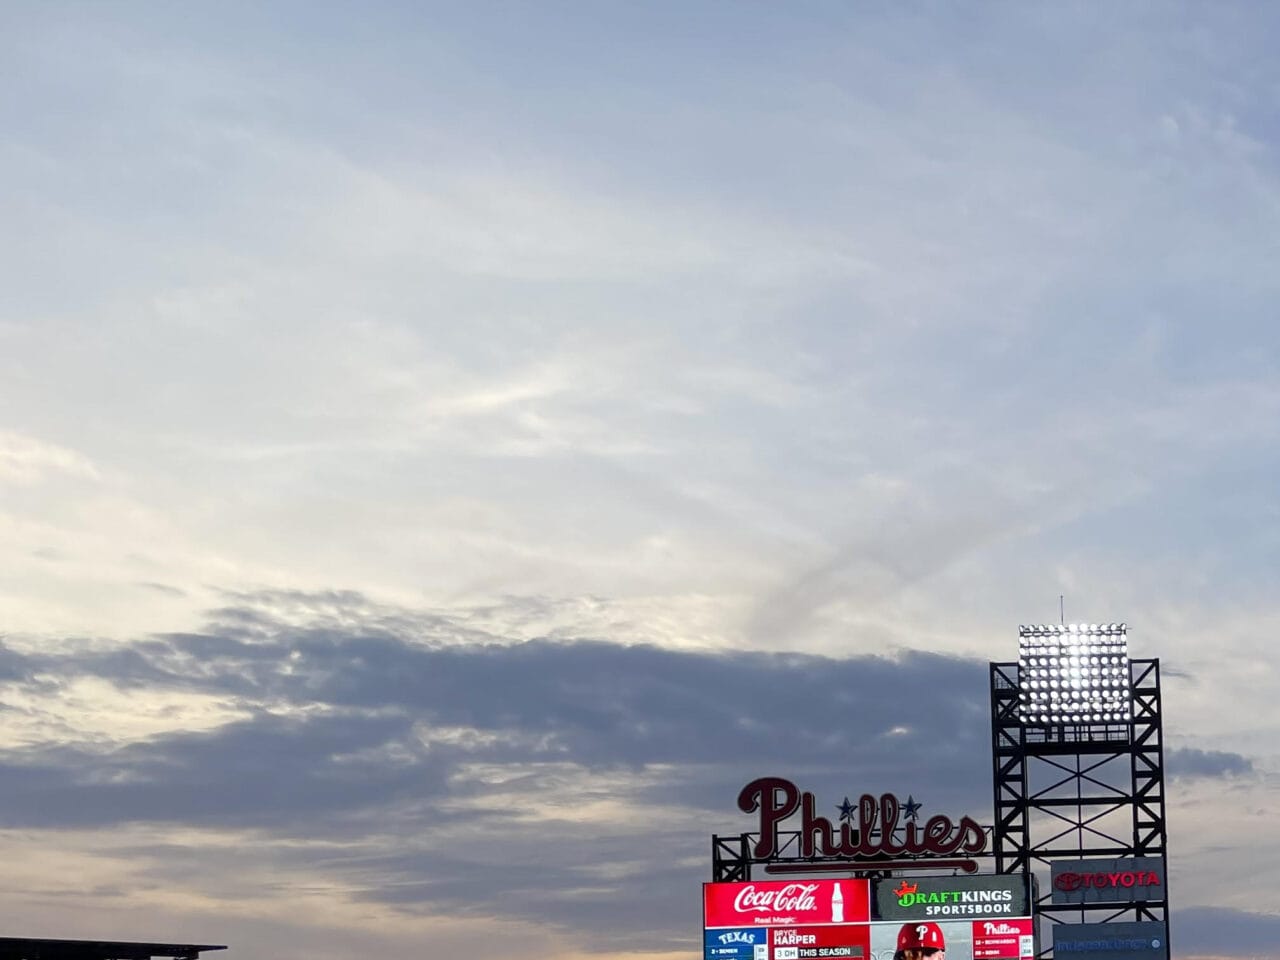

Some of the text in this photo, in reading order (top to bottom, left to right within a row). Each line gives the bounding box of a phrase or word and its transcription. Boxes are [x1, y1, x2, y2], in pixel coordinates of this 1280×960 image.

[738, 776, 986, 859] Phillies
[1082, 871, 1160, 888] TOYOTA
[734, 884, 820, 912] Coca-Cola
[898, 890, 1012, 906] DRAFTKINGS
[926, 903, 1011, 915] SPORTSBOOK
[983, 922, 1020, 935] Phillies
[718, 931, 755, 944] TEXAS
[773, 935, 816, 945] HARPER
[800, 948, 851, 957] THIS SEASON
